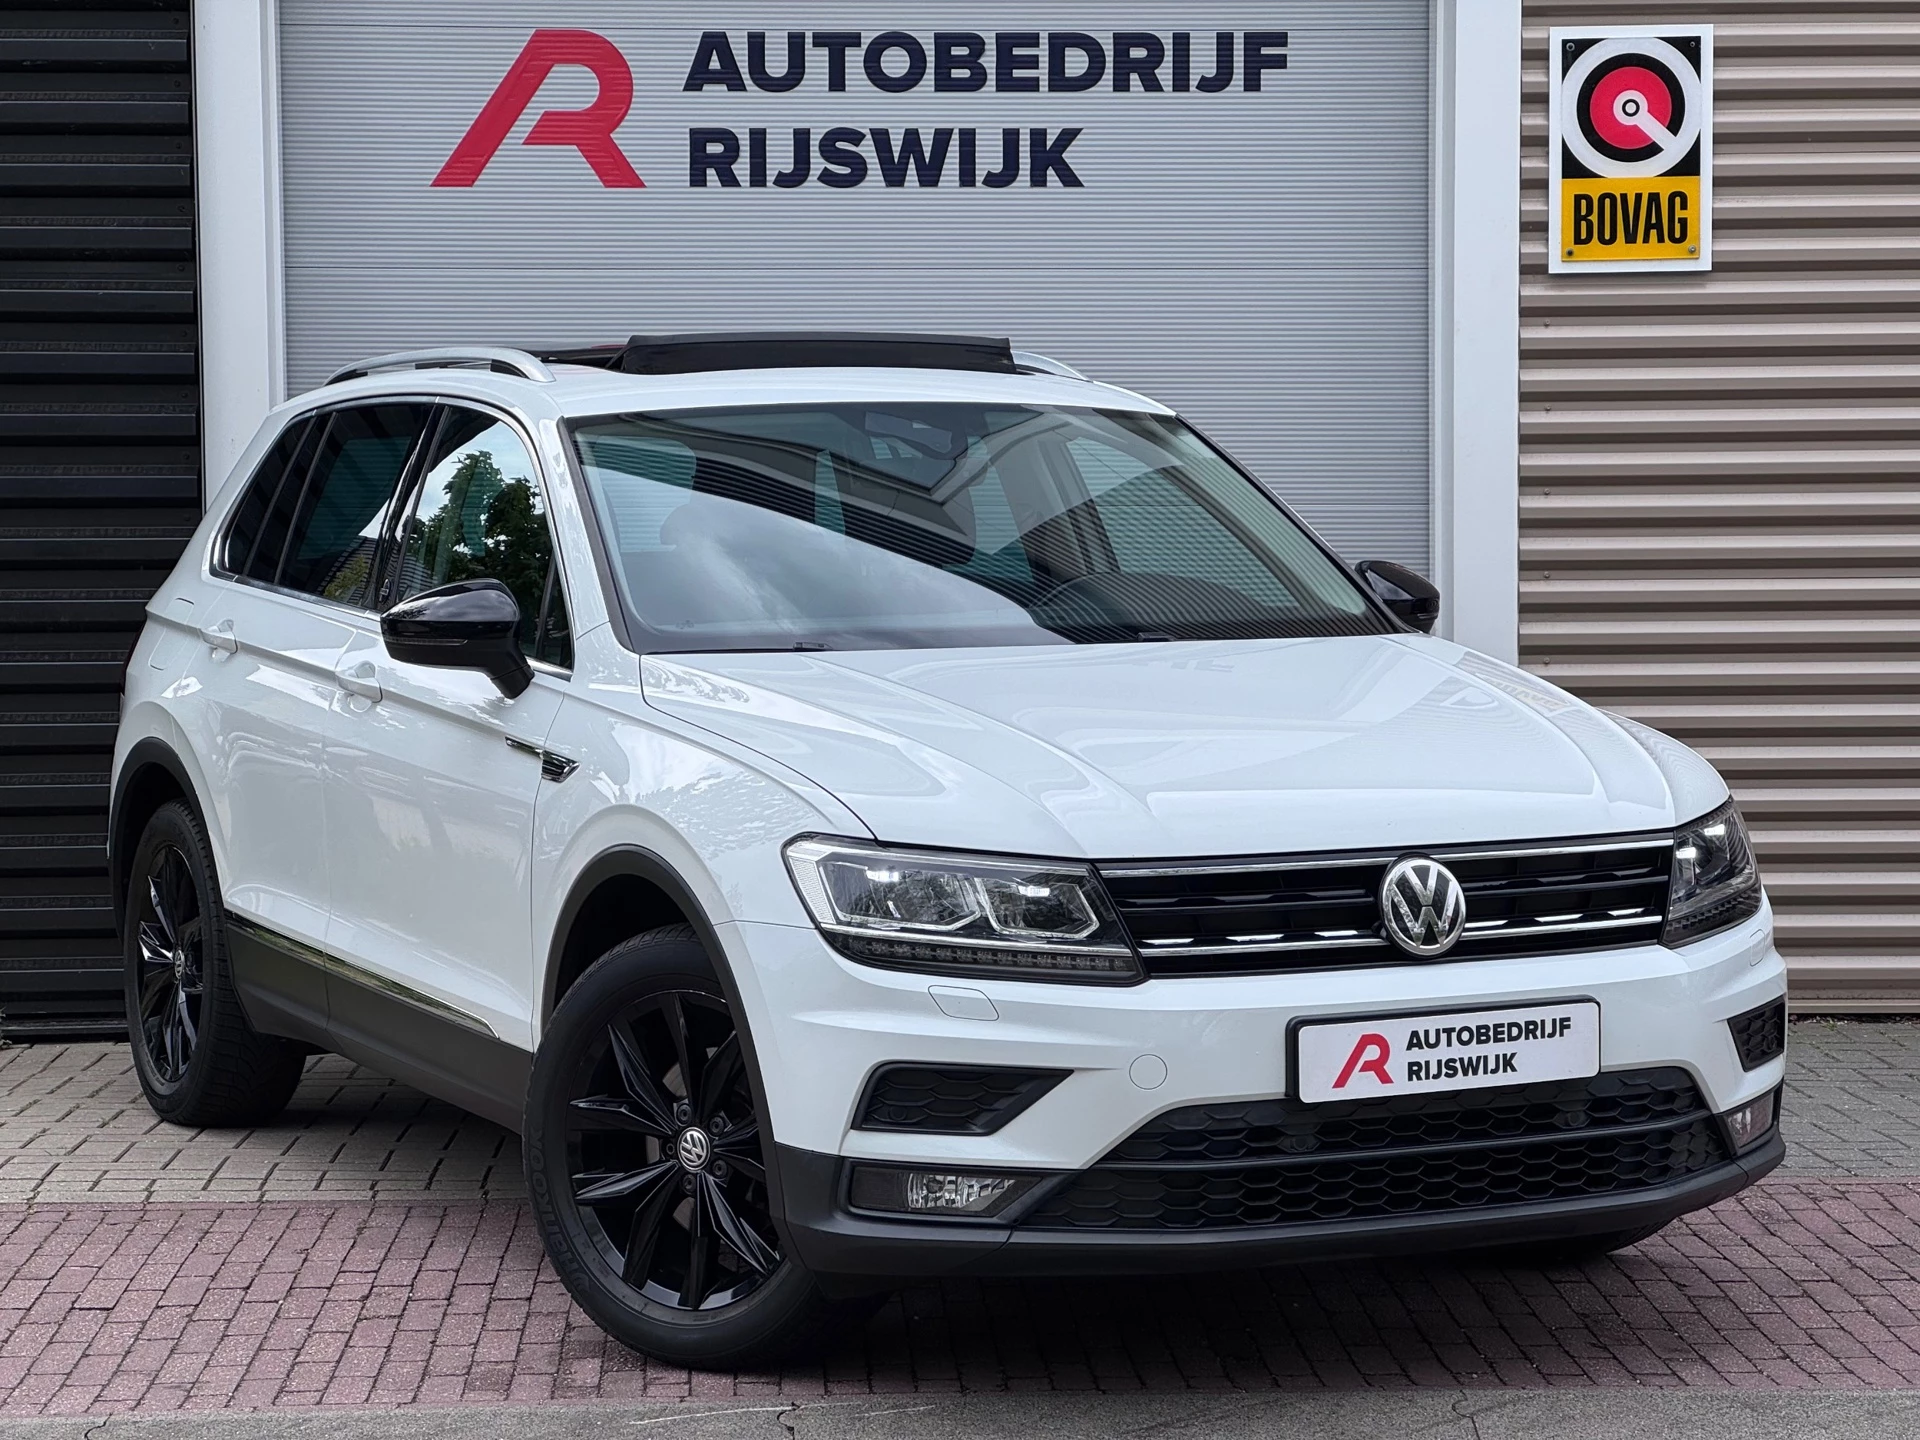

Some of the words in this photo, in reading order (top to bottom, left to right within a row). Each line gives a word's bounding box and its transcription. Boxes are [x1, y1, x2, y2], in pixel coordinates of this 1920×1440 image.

[683, 30, 1289, 94] AUTOBEDRIJF
[688, 127, 1085, 189] RIJSWIJK
[1573, 190, 1688, 246] BOVAG
[1405, 1017, 1571, 1051] AUTOBEDRIJF
[1407, 1052, 1518, 1082] RIJSWIJK
